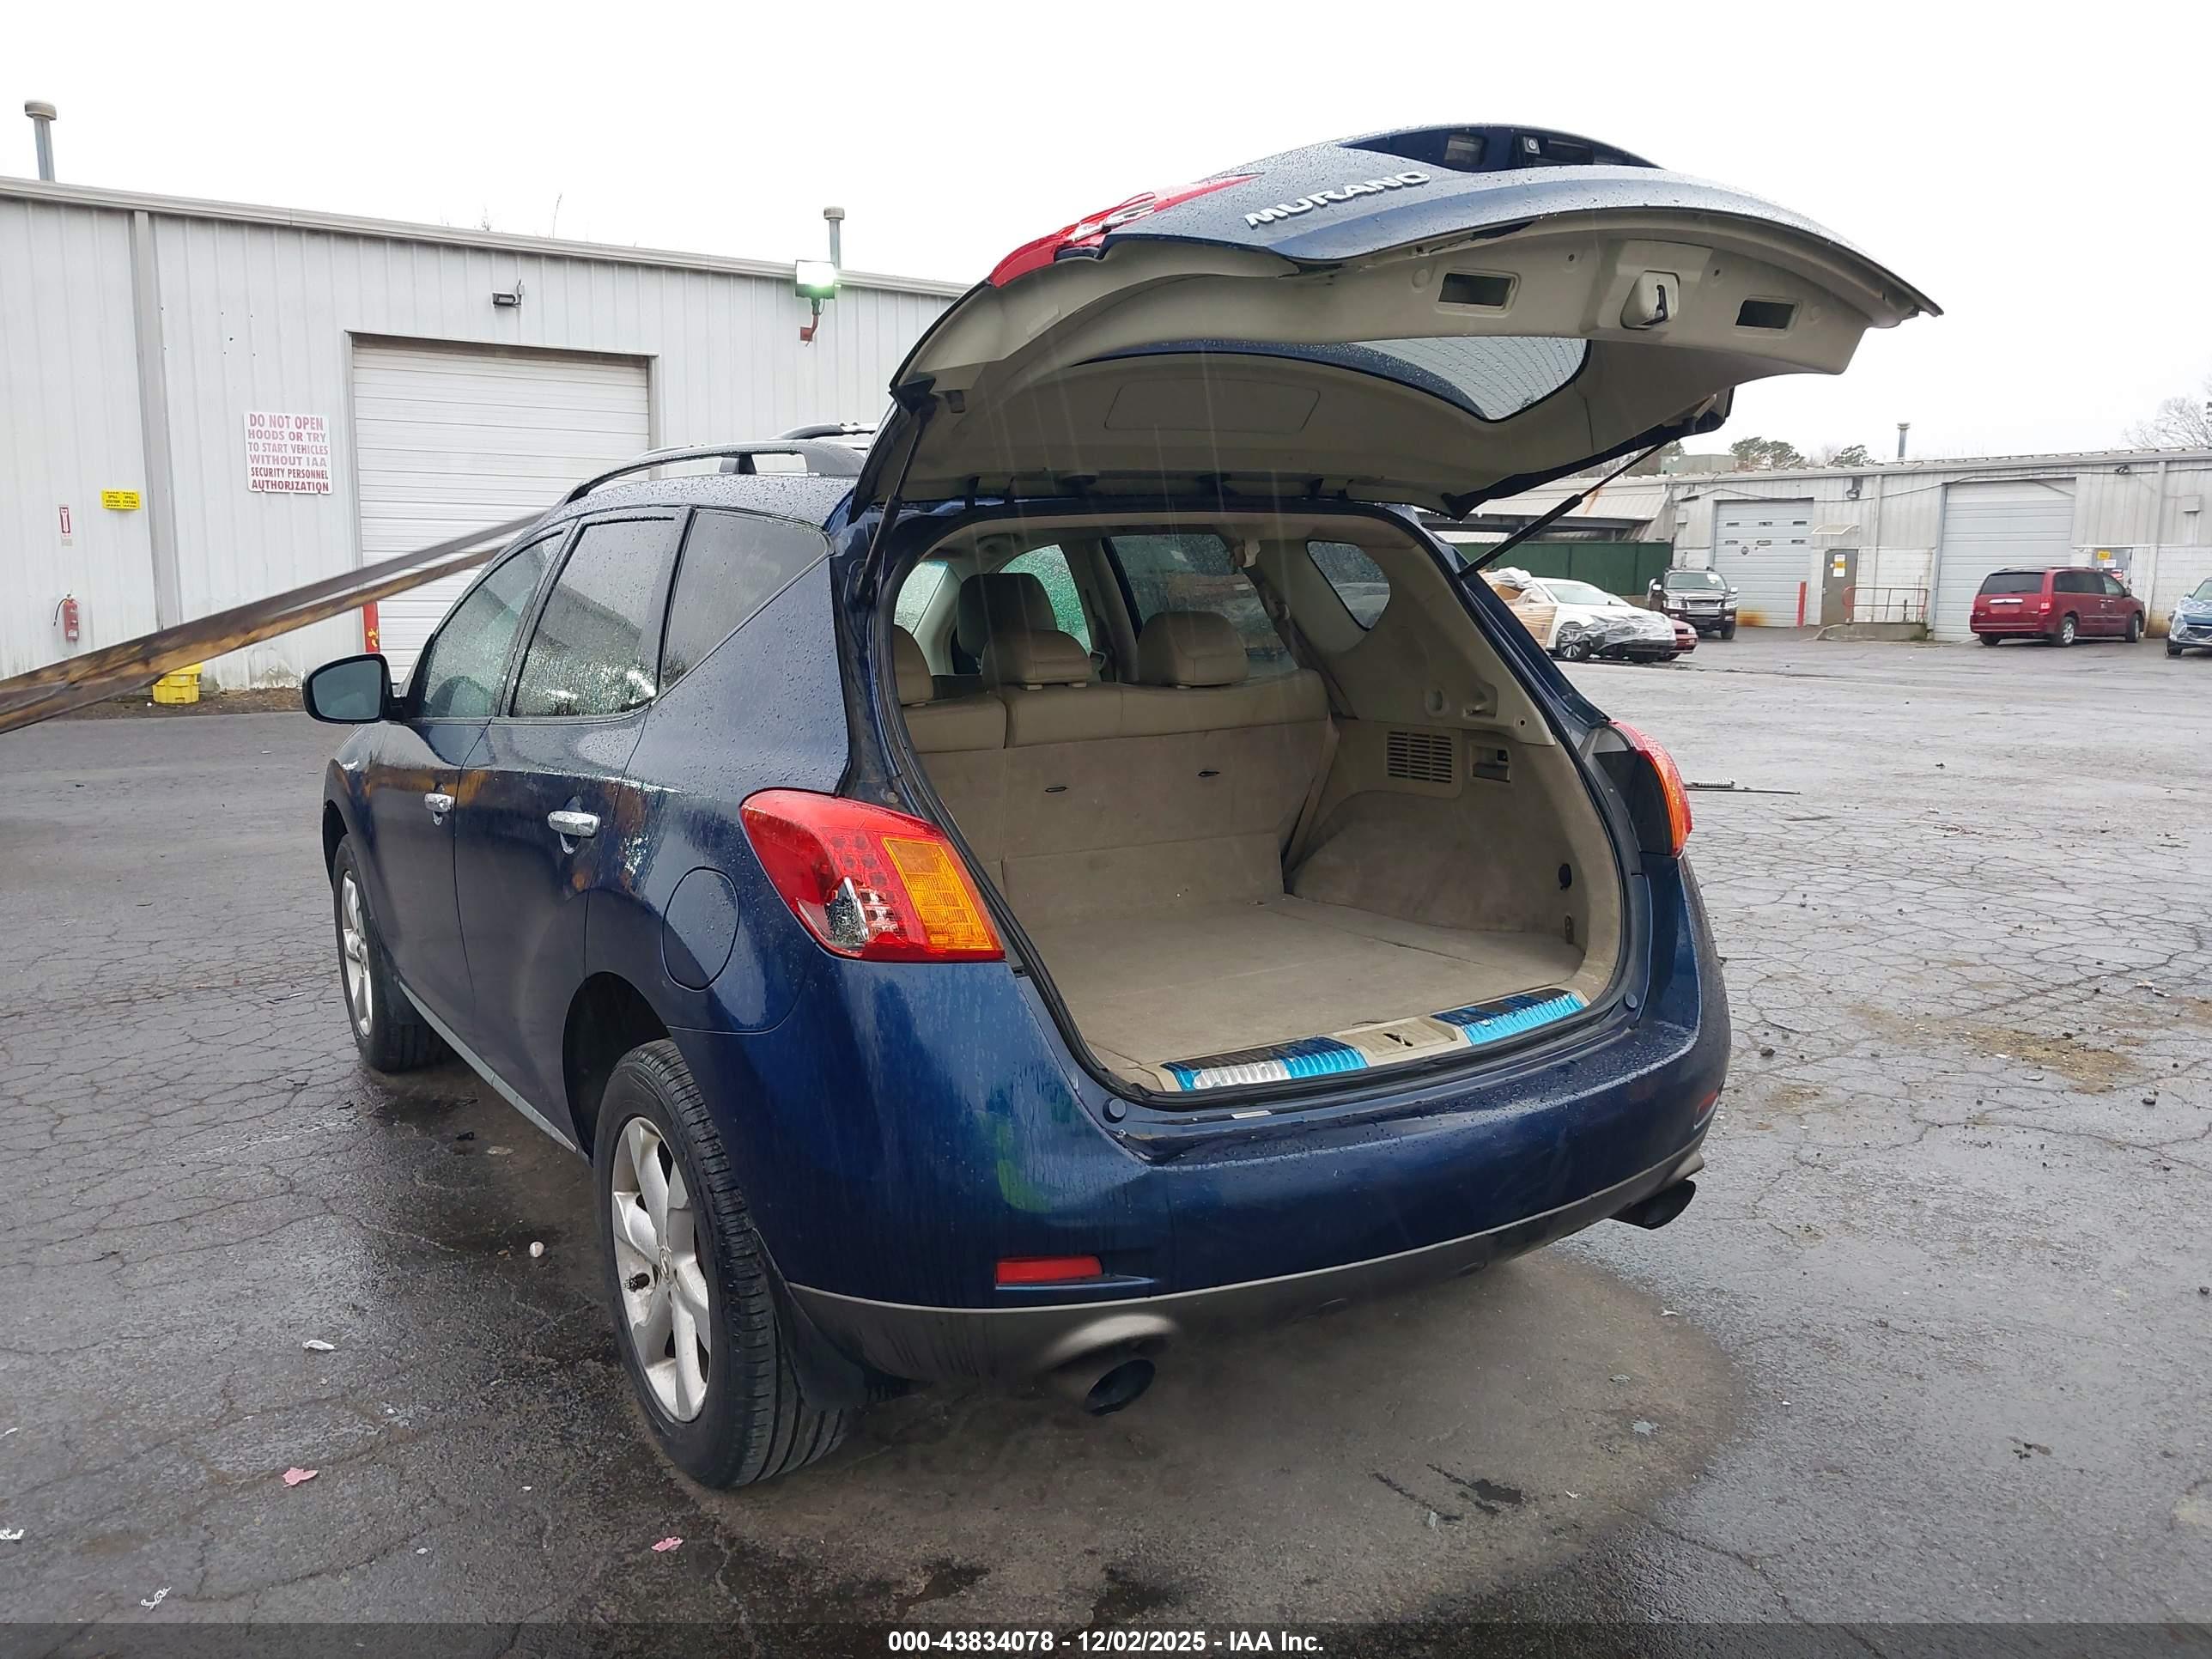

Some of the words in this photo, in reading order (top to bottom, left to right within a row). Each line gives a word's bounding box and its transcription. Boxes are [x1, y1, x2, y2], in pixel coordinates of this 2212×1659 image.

[1245, 171, 1431, 229] MURANO
[249, 413, 265, 427] DO
[269, 415, 290, 428] NOT
[295, 416, 324, 430] OPEN
[248, 429, 285, 441] HOODS
[289, 431, 303, 441] OR
[307, 432, 326, 442] TRY
[248, 441, 259, 452] TO
[262, 443, 288, 453] START
[290, 444, 328, 455] VEHICLES
[249, 454, 303, 466] WITHOUT
[307, 457, 327, 467] IAA
[251, 467, 285, 477] SECURITY
[288, 468, 329, 480] PERSONNEL
[252, 479, 329, 491] AUTHORIZATION
